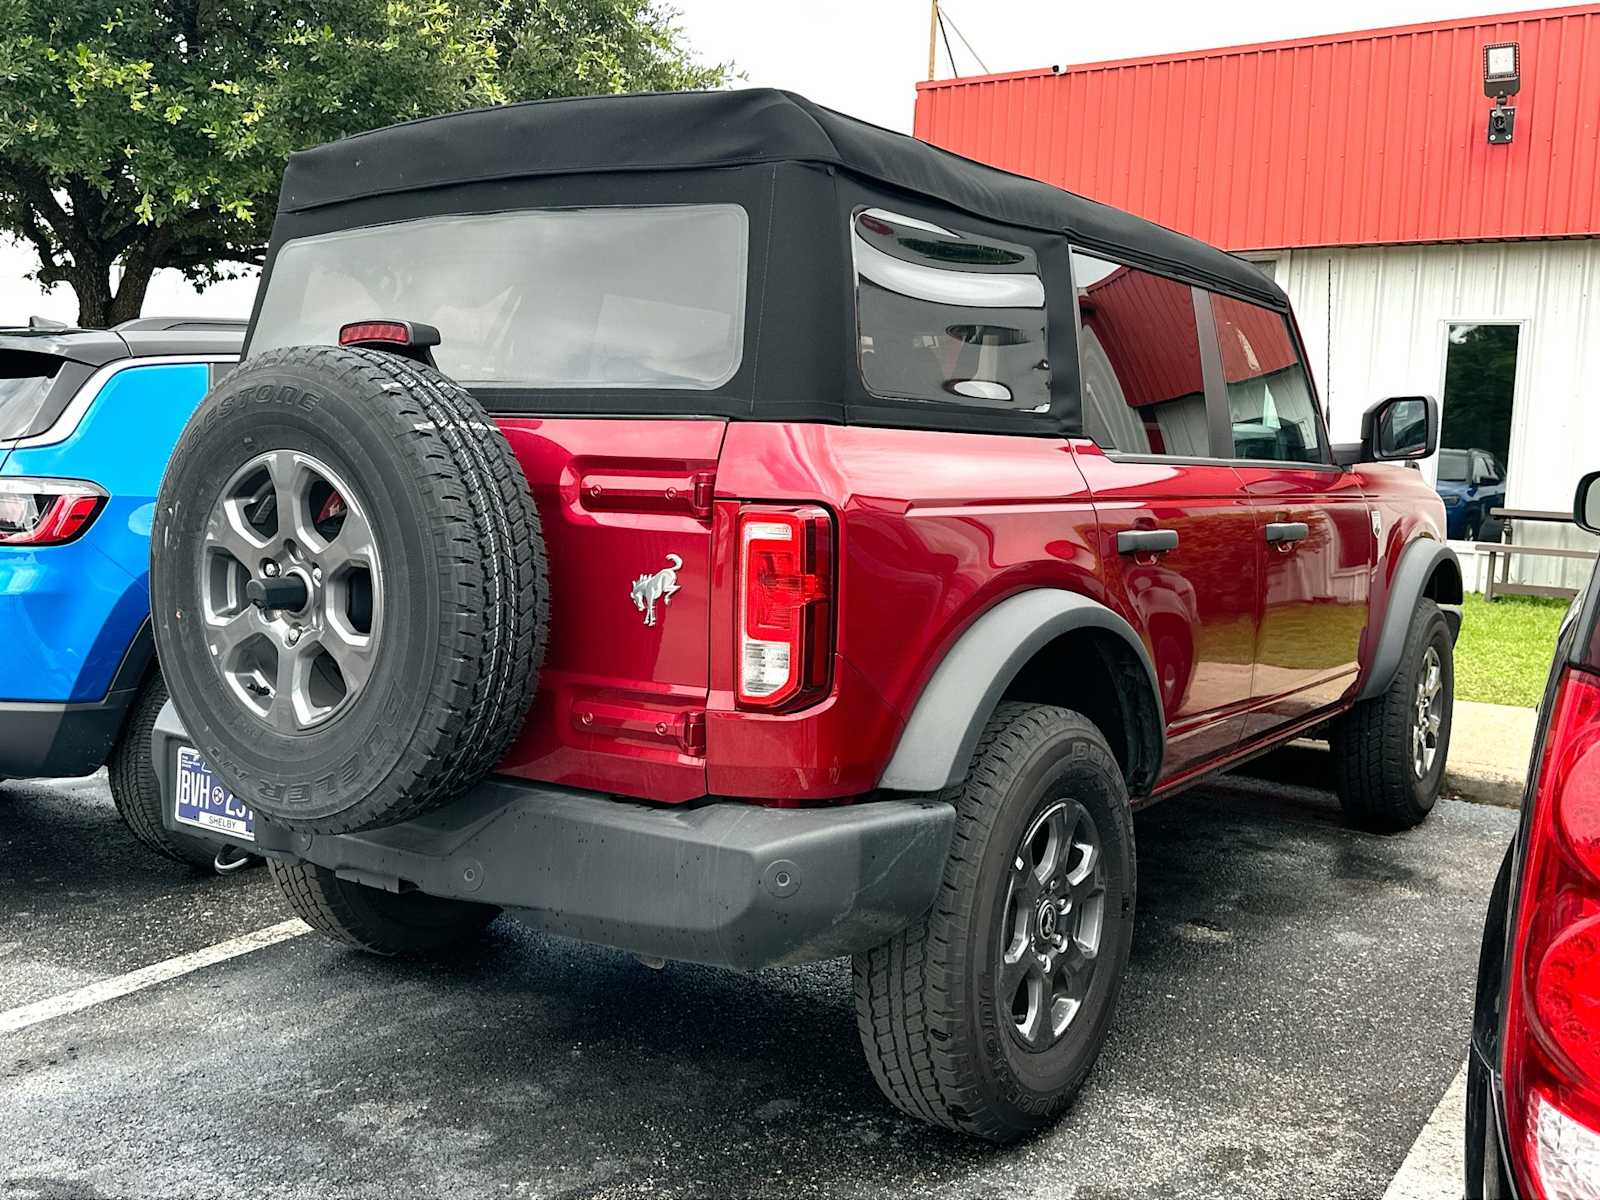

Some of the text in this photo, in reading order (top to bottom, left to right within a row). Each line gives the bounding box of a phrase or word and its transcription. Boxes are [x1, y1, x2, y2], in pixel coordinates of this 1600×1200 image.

[166, 384, 322, 488] DGESTONE
[180, 770, 211, 809] BVH
[208, 816, 237, 830] SHELBY
